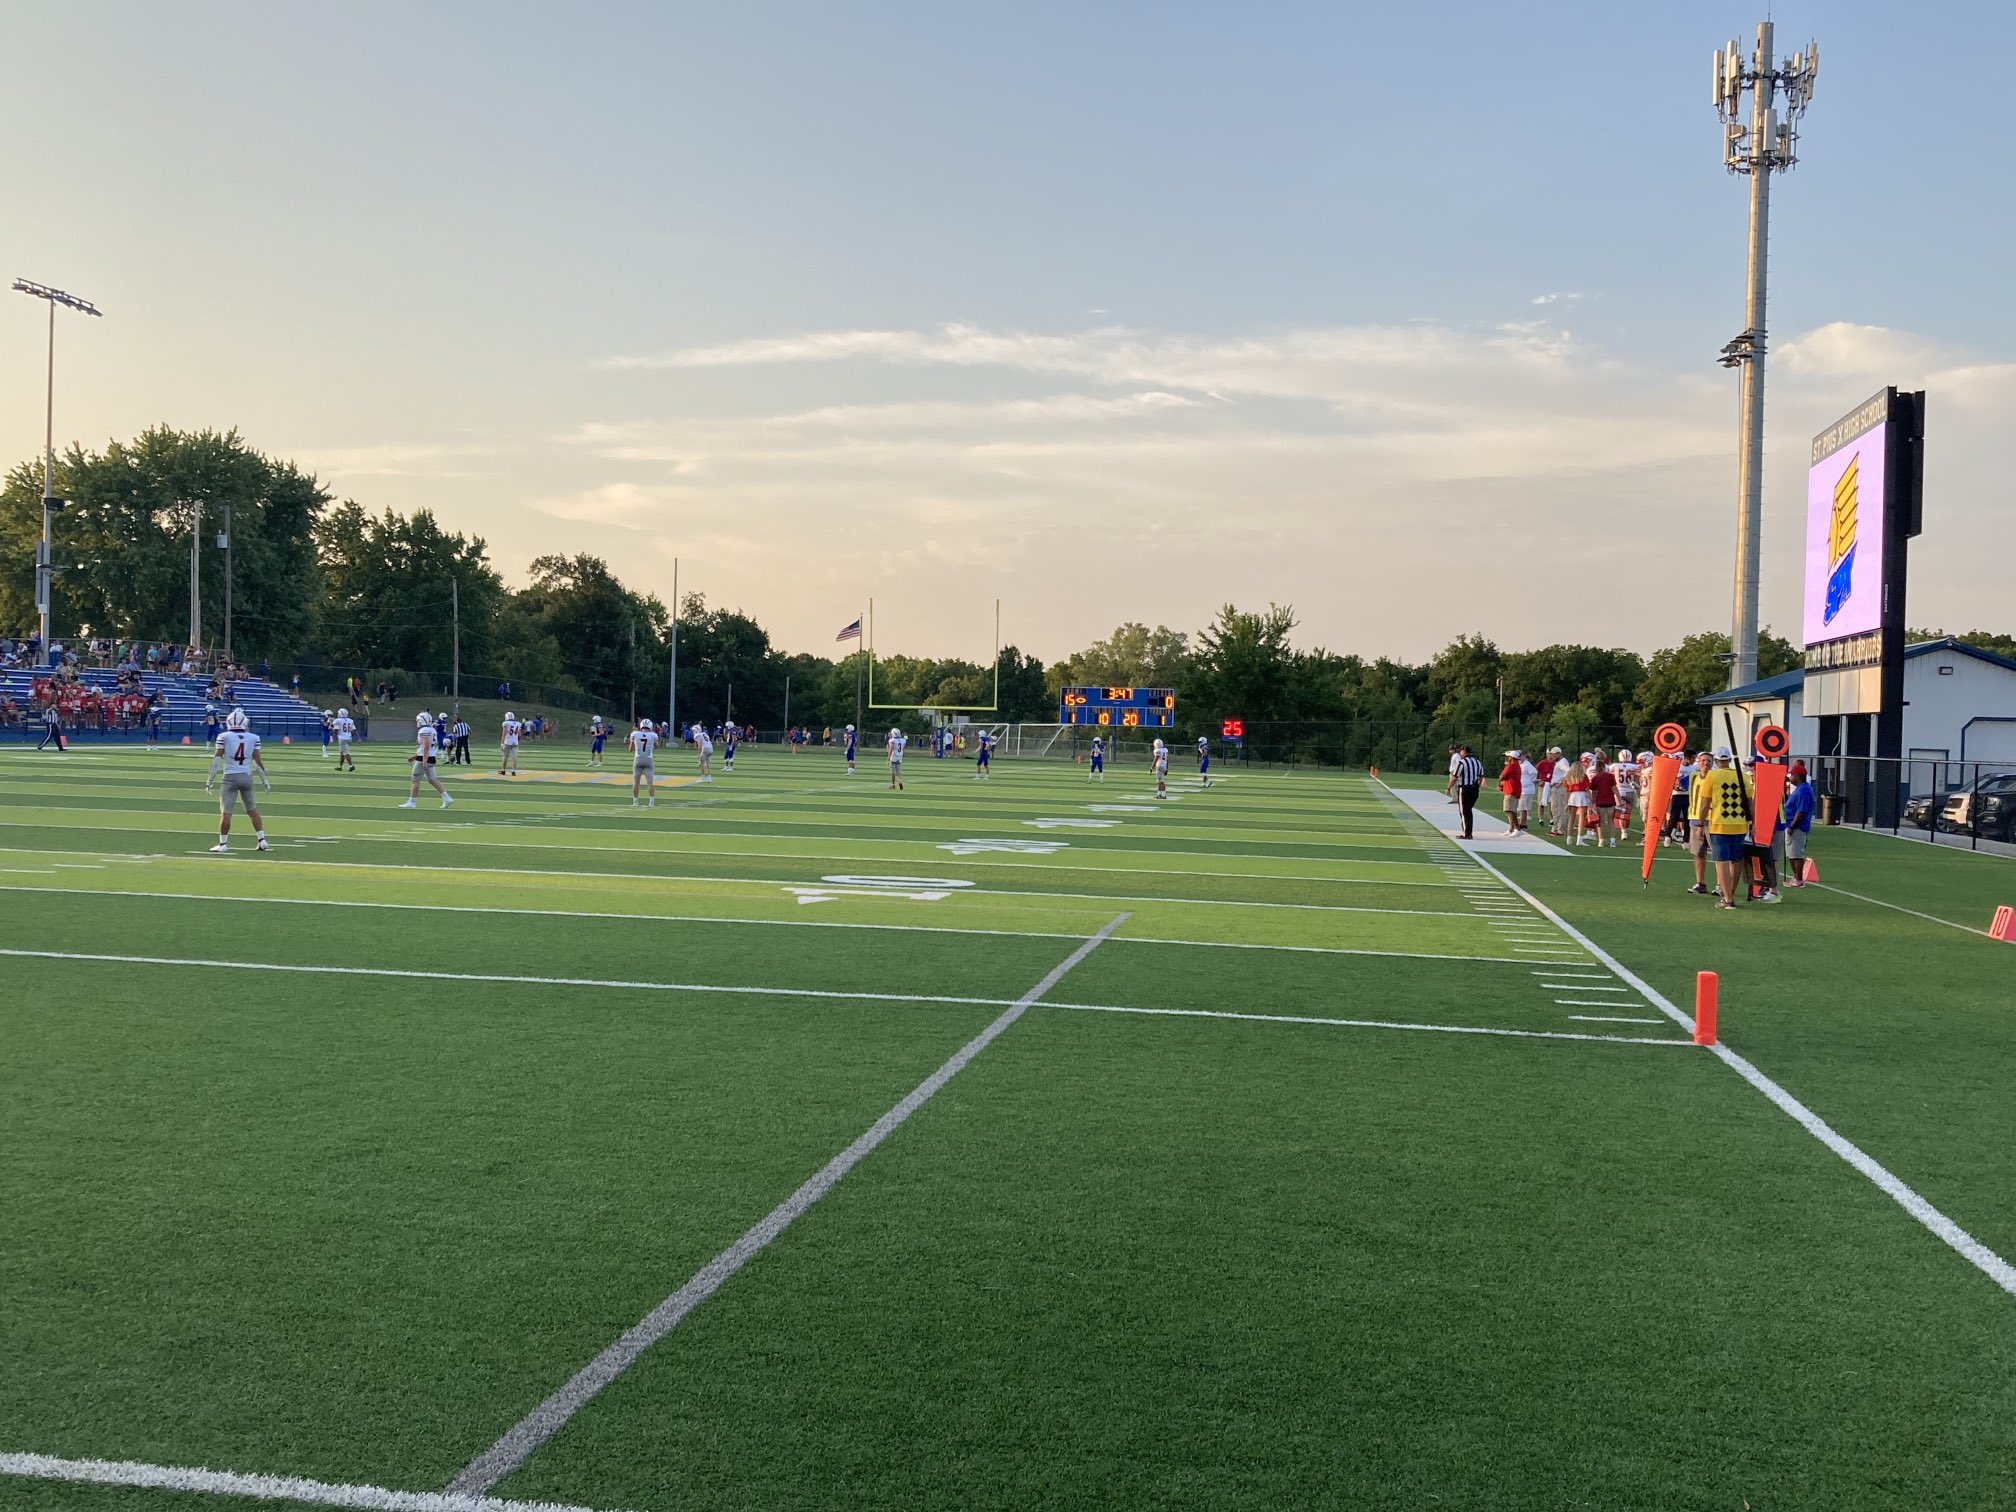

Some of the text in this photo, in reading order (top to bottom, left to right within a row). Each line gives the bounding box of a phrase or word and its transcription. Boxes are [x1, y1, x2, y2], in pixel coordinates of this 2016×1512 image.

[1823, 430, 1837, 456] PIUS
[1844, 414, 1860, 443] HIGH
[1860, 396, 1886, 430] SCHOOL
[1065, 694, 1075, 705] 15
[1109, 688, 1132, 699] 3:47
[1165, 697, 1173, 708] 0
[1098, 713, 1109, 725] 10
[1123, 713, 1137, 726] 20
[1223, 721, 1242, 736] 25
[640, 739, 648, 752] 7
[234, 743, 246, 765] 4
[1991, 907, 2009, 937] 10
